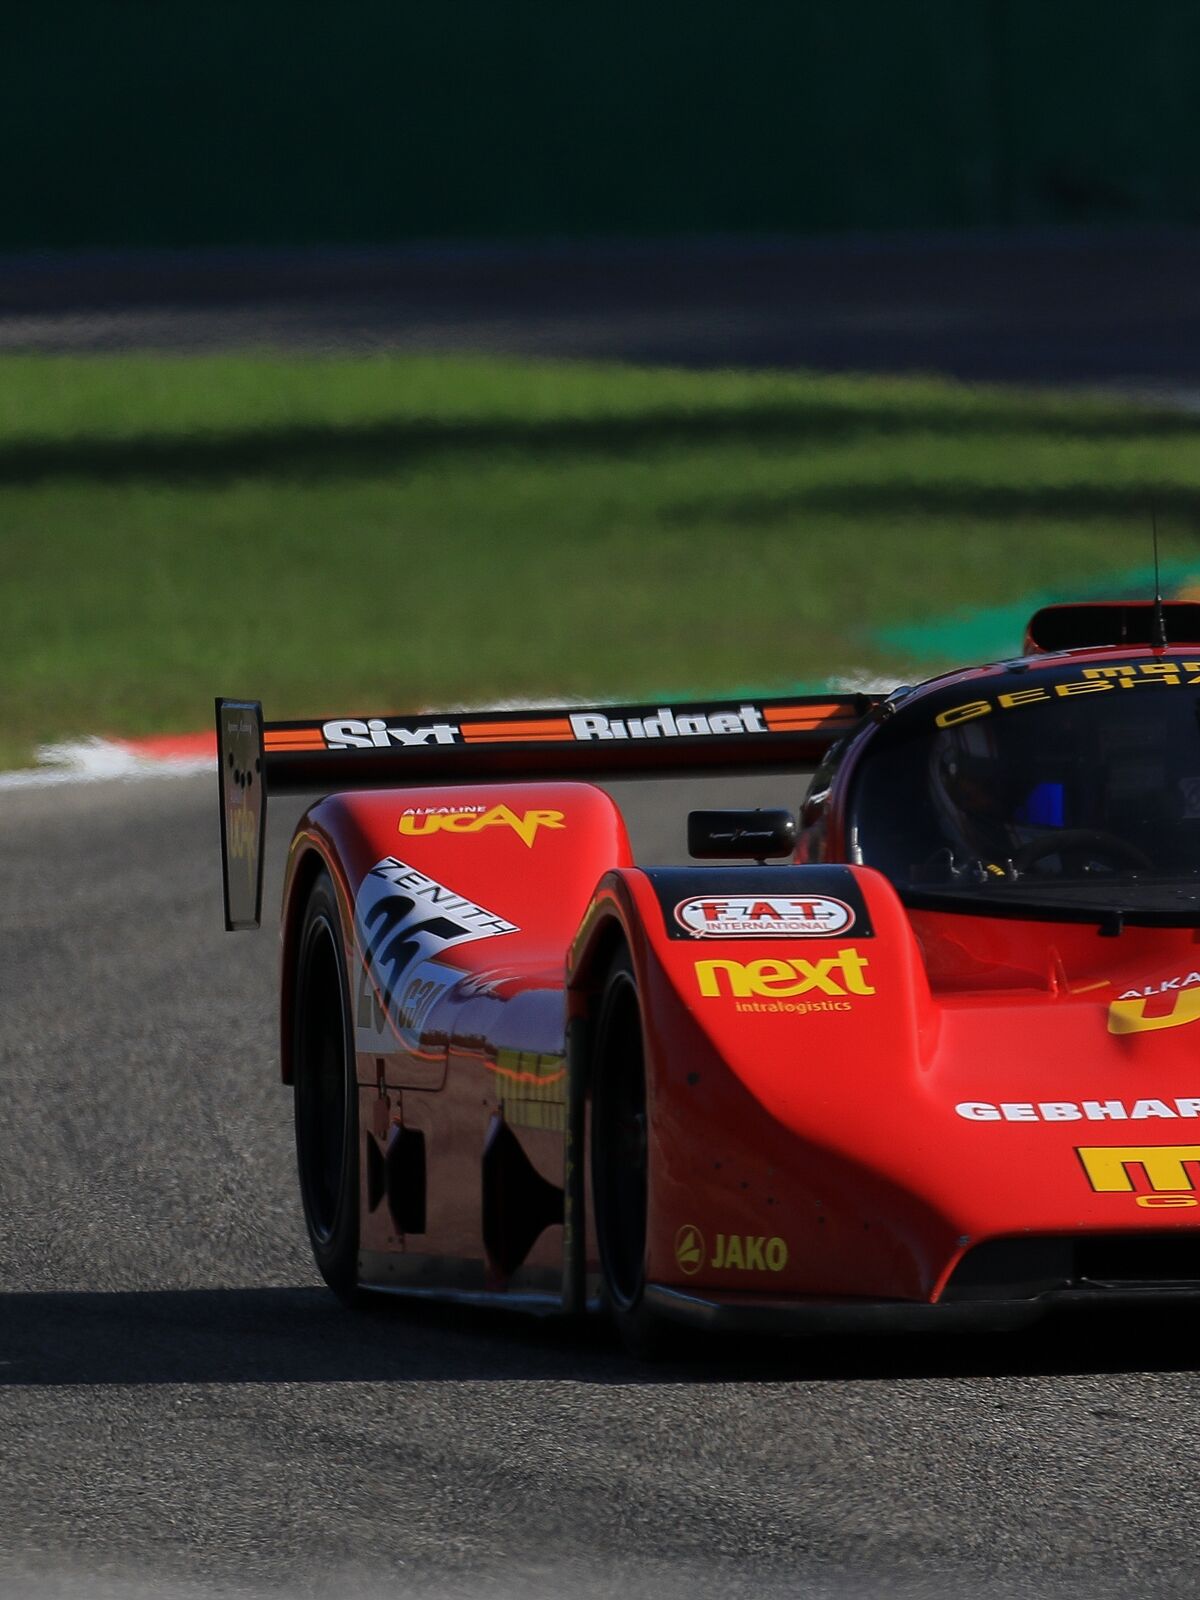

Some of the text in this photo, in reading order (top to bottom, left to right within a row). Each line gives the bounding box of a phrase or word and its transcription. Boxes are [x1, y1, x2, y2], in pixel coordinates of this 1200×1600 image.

[322, 718, 461, 750] Sixt
[398, 804, 566, 848] UCAR
[402, 805, 486, 816] ALKALINE
[369, 857, 518, 935] ZENITH
[706, 921, 833, 932] INTERNATIONAL
[694, 948, 876, 998] next
[735, 1001, 852, 1014] intralogistics
[711, 1234, 788, 1272] JAKO
